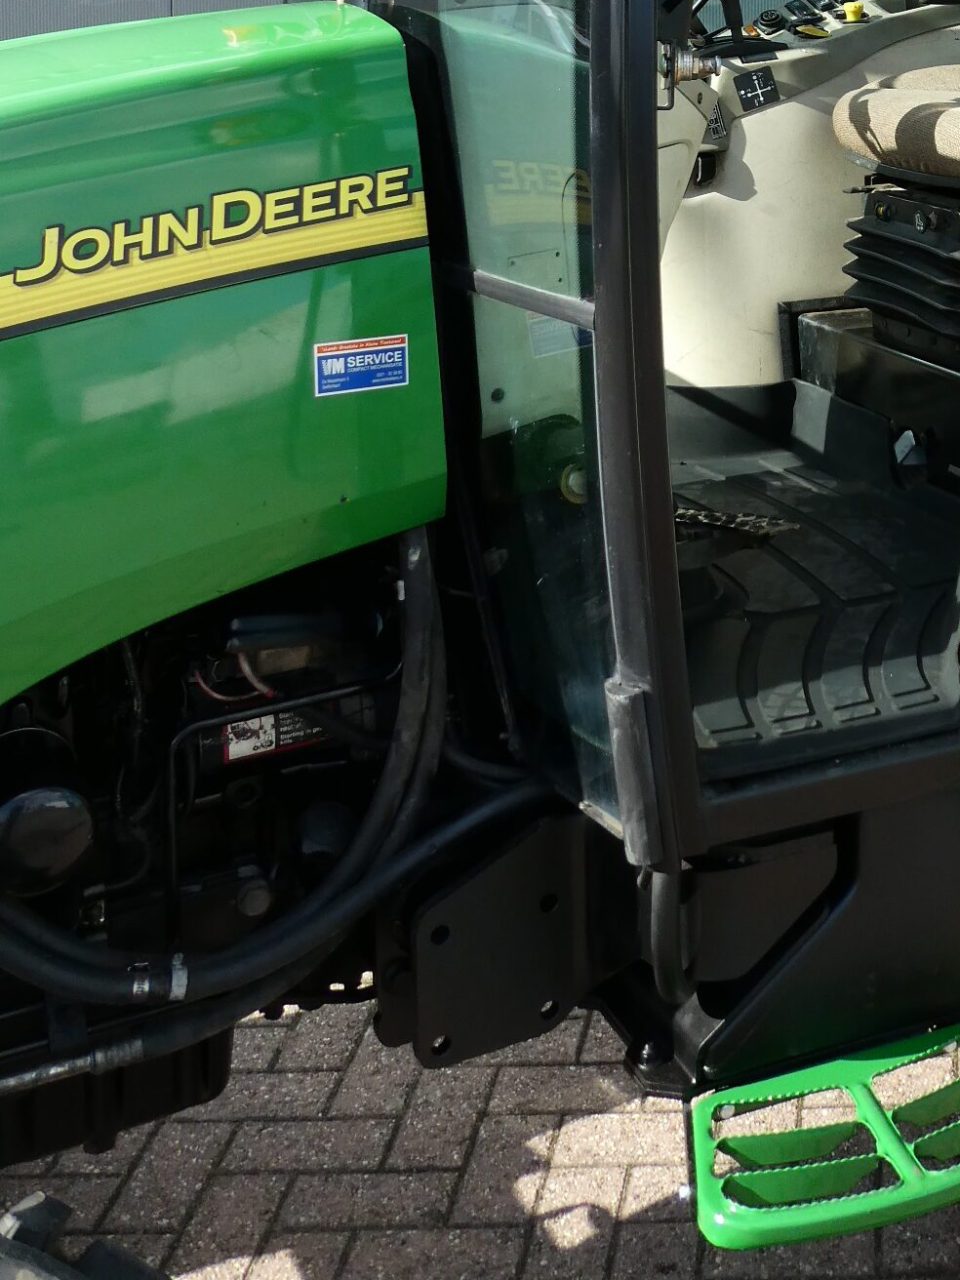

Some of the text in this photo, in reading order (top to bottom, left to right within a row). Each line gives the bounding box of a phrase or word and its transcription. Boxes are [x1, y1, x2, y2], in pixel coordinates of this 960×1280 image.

[14, 166, 412, 286] JOHN DEERE
[346, 350, 403, 368] SERVICE
